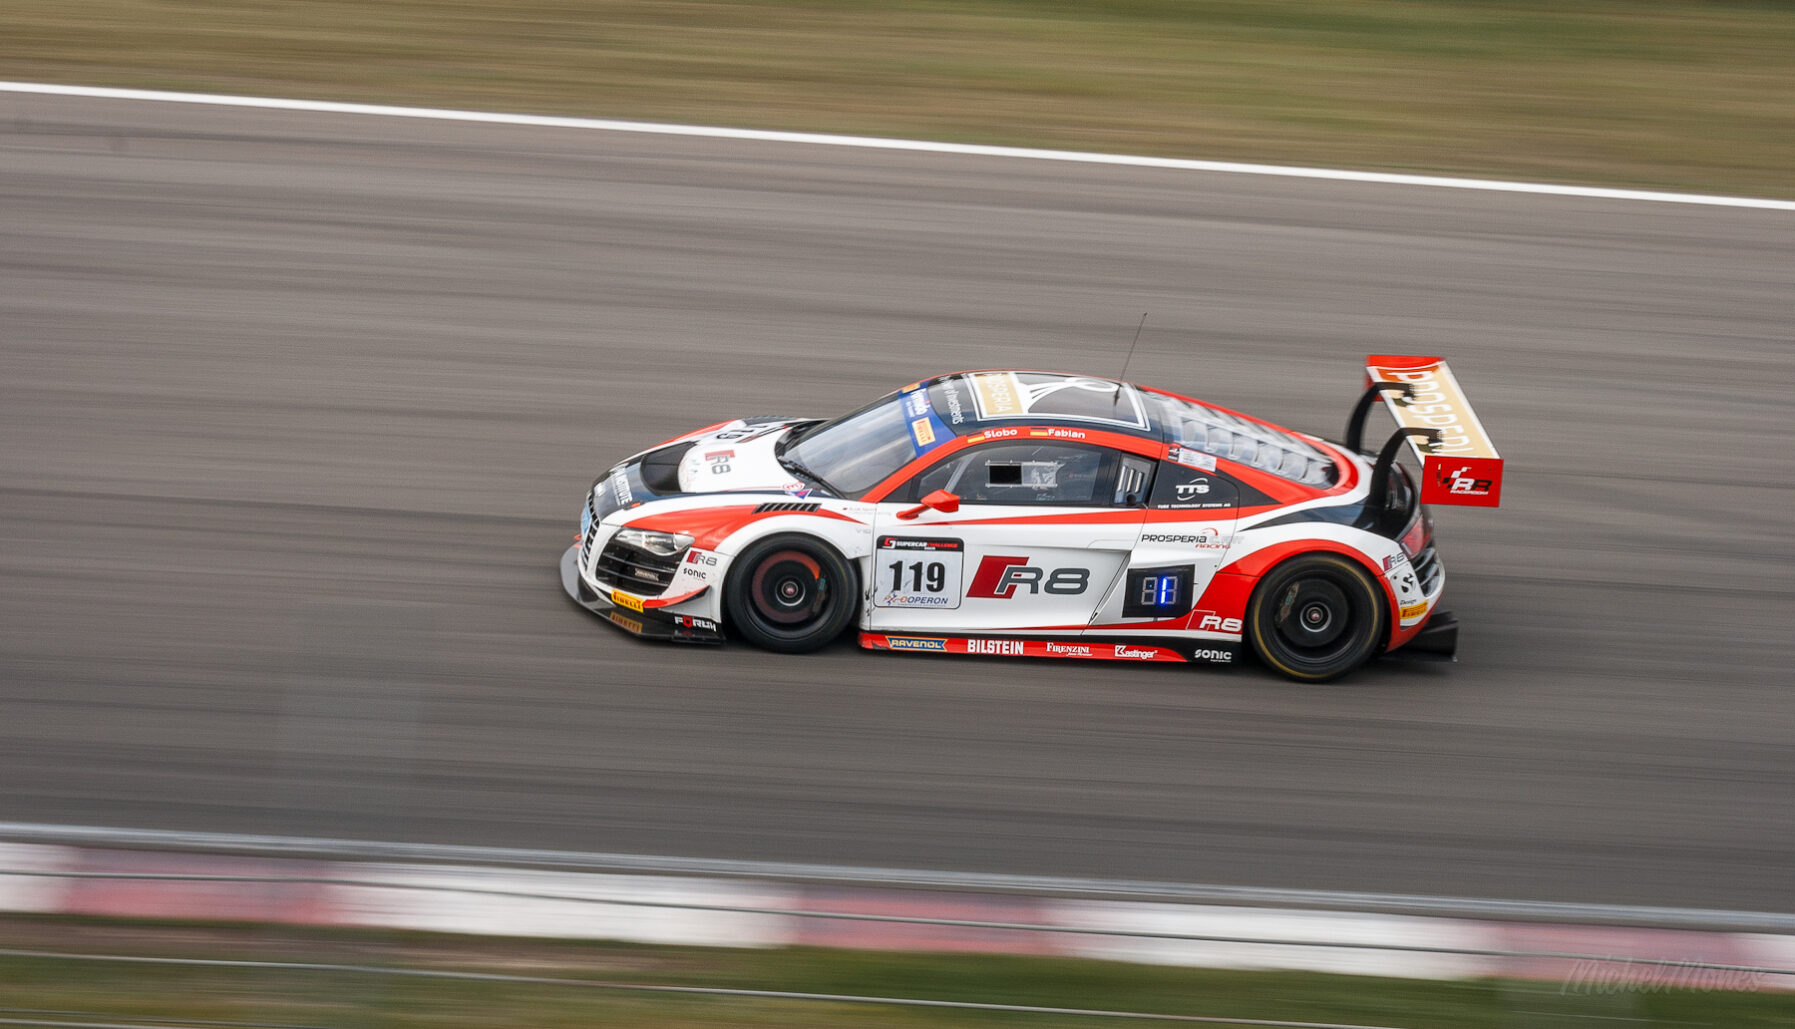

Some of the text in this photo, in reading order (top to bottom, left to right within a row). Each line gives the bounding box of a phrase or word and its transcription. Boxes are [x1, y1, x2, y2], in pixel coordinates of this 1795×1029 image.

[984, 428, 1018, 439] Slobo
[1047, 428, 1086, 439] Fabian
[1176, 484, 1210, 494] TTS
[889, 560, 946, 593] 119
[993, 565, 1091, 596] R8
[613, 591, 641, 610] PIRELLI
[1200, 615, 1243, 633] R8
[891, 639, 941, 649] RAVENOL
[967, 638, 1024, 655] BILSTEIN
